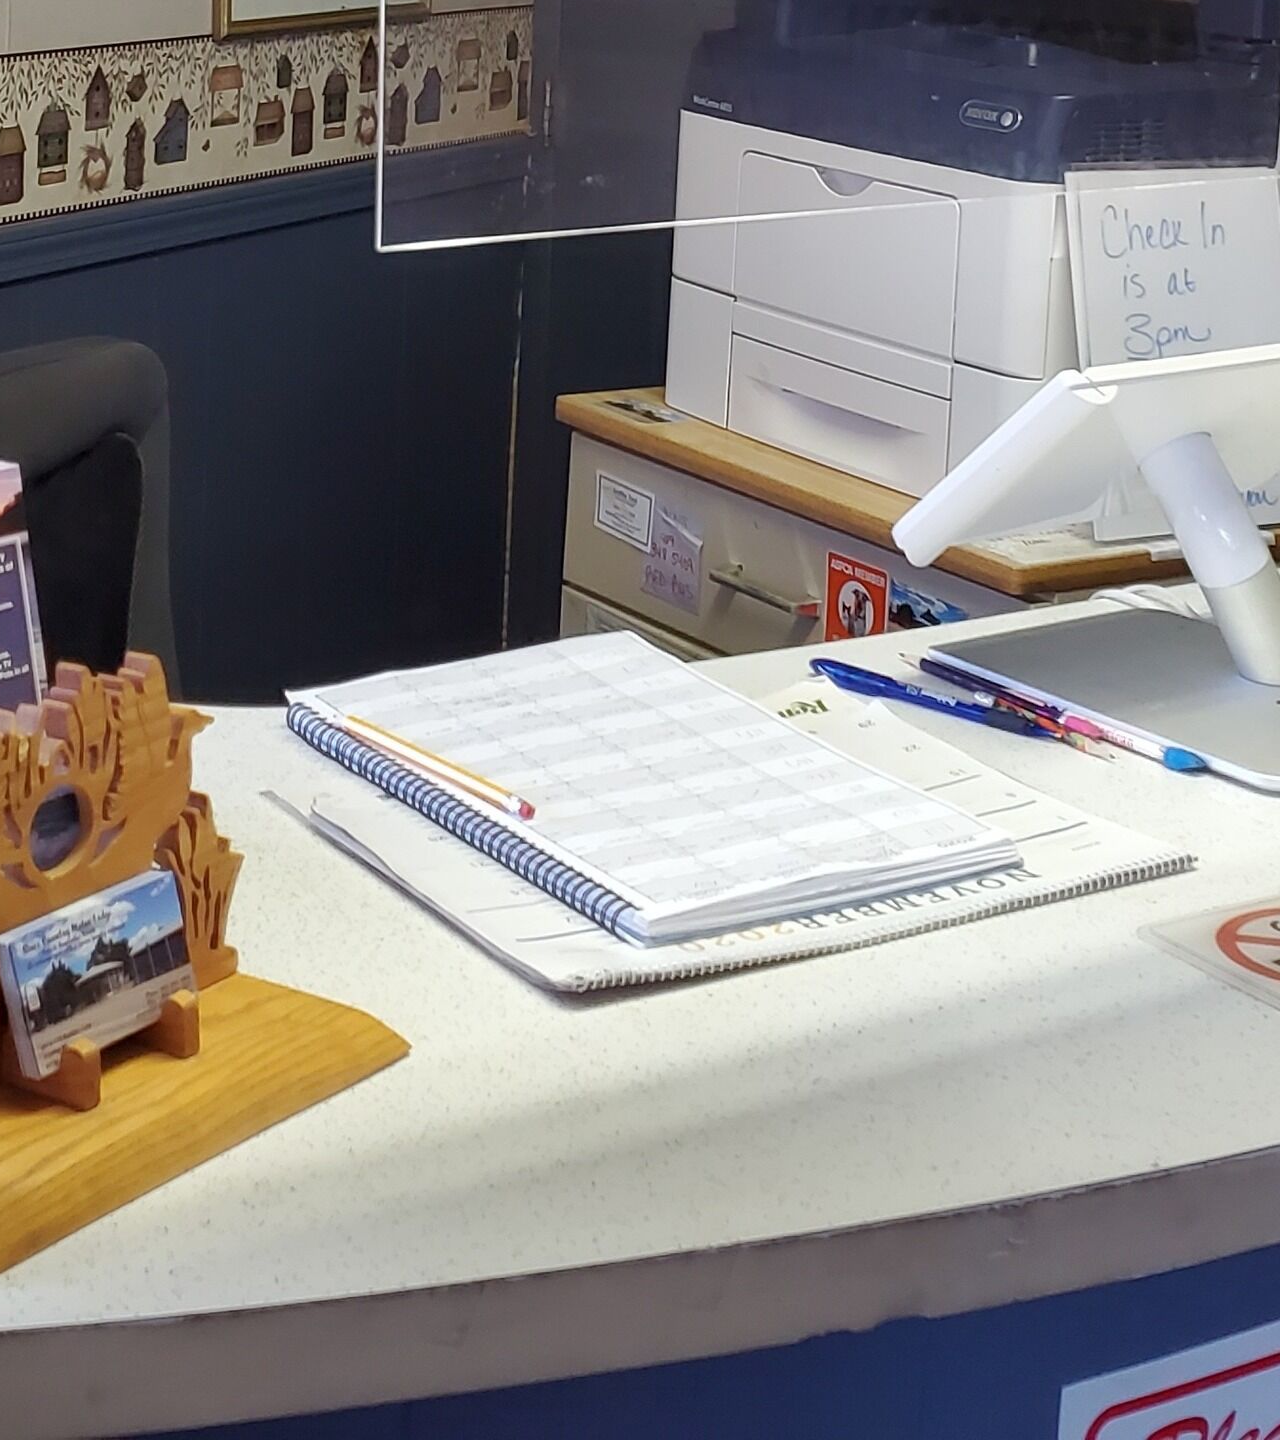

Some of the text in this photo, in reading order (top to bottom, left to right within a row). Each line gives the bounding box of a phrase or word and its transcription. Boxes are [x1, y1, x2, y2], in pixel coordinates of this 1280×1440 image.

[1100, 200, 1226, 259] Check In
[1122, 264, 1197, 298] is at
[1123, 313, 1212, 357] 3pm
